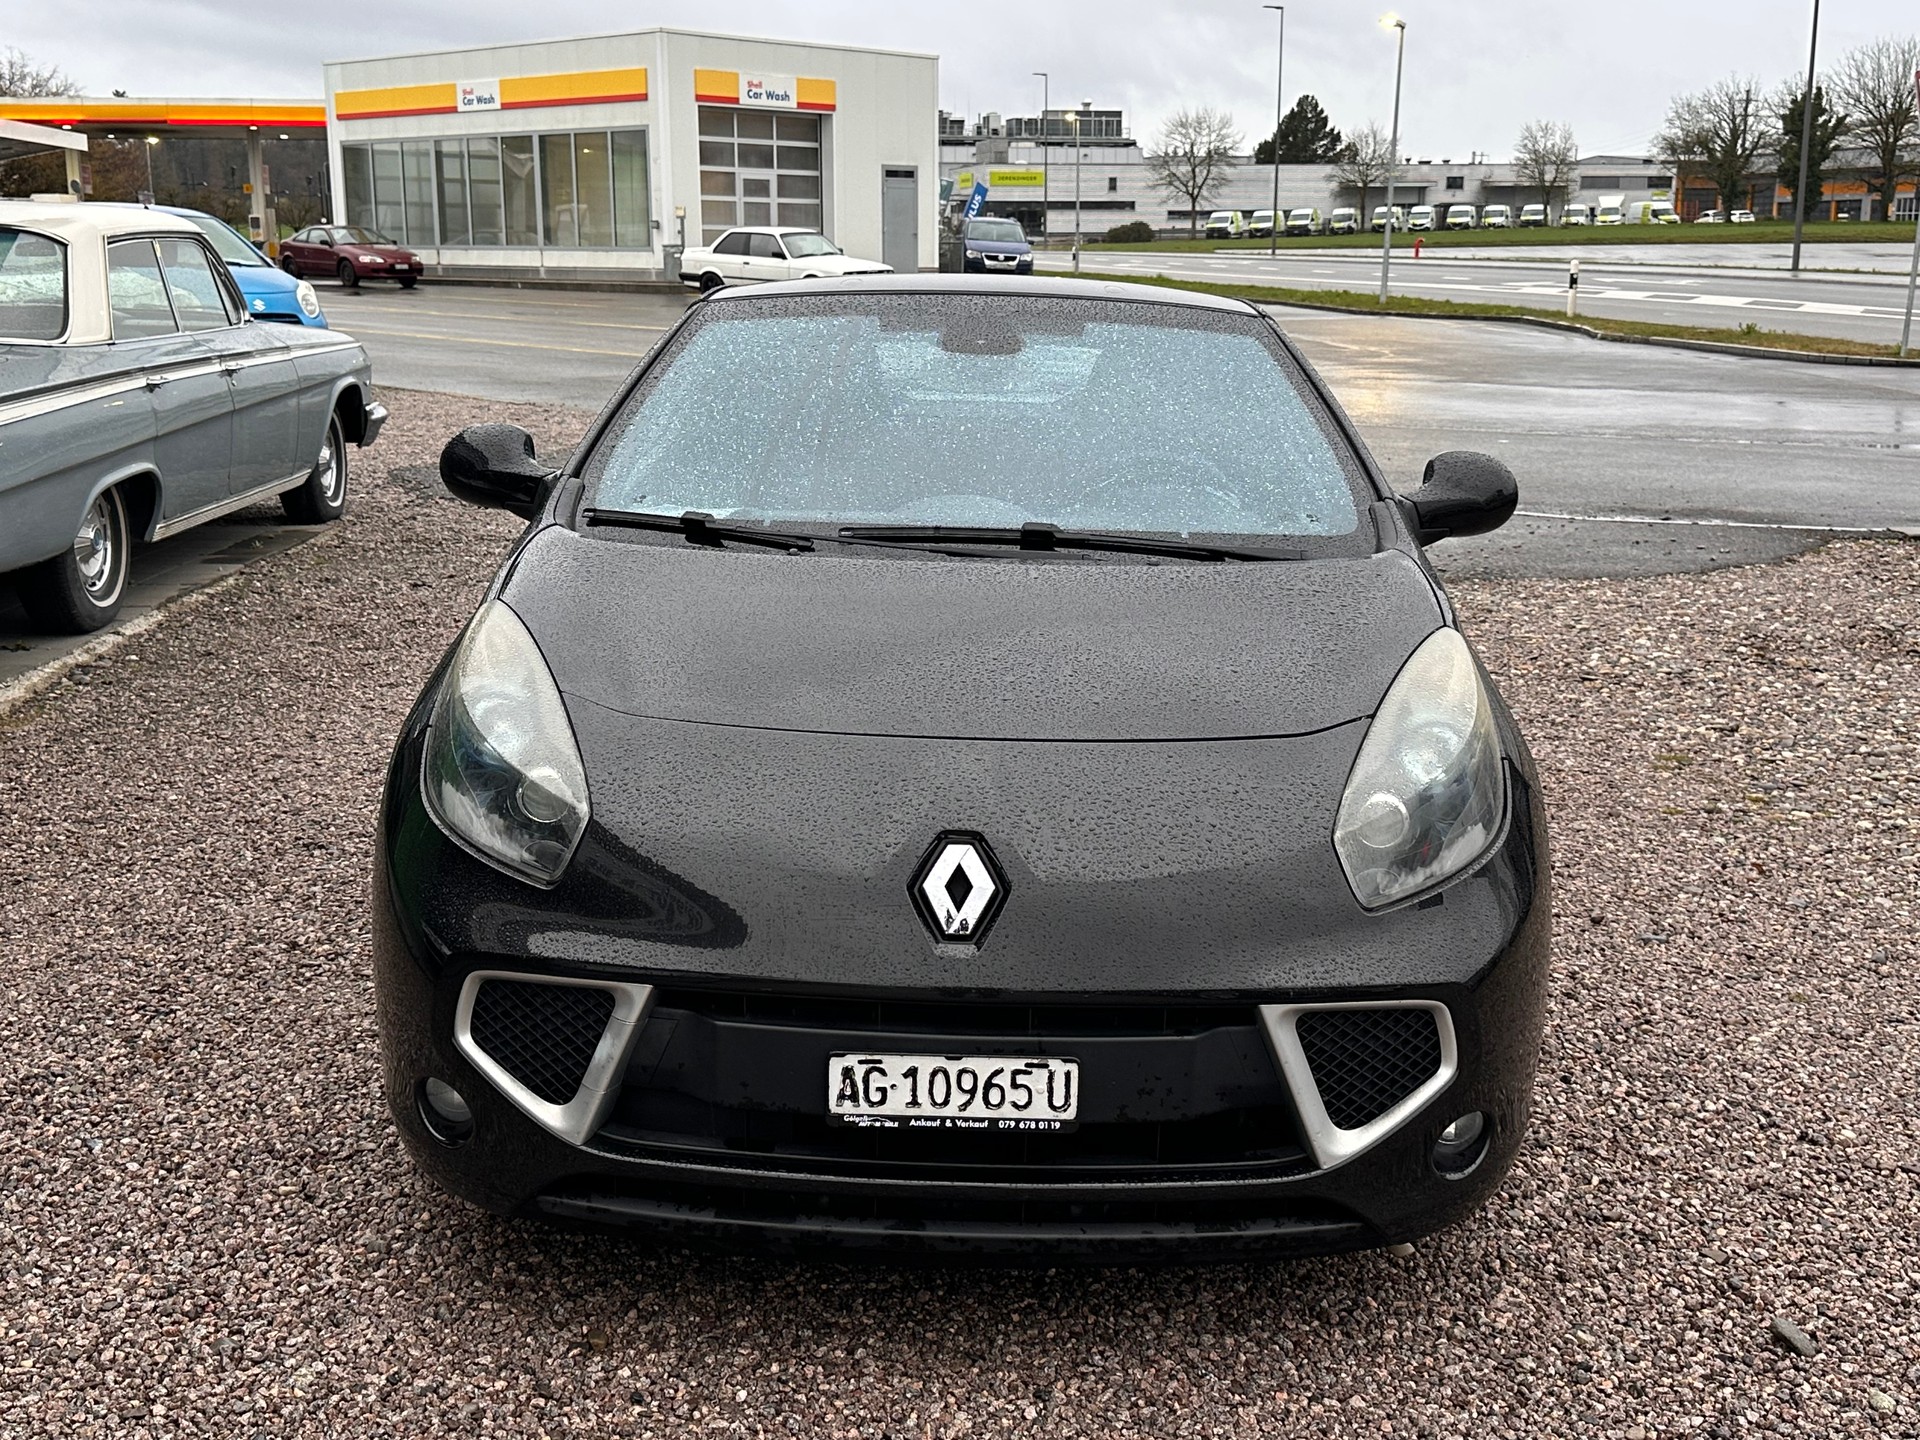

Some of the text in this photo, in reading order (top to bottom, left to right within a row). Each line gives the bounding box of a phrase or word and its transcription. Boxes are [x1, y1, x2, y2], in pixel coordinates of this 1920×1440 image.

[747, 80, 763, 89] Shell
[462, 94, 496, 106] Car Wash
[747, 89, 790, 102] Car Wash
[909, 1118, 941, 1127] Ankauf
[945, 1119, 952, 1127] &
[955, 1119, 988, 1128] Verkauf
[998, 1120, 1016, 1129] 079
[1019, 1120, 1036, 1130] 678
